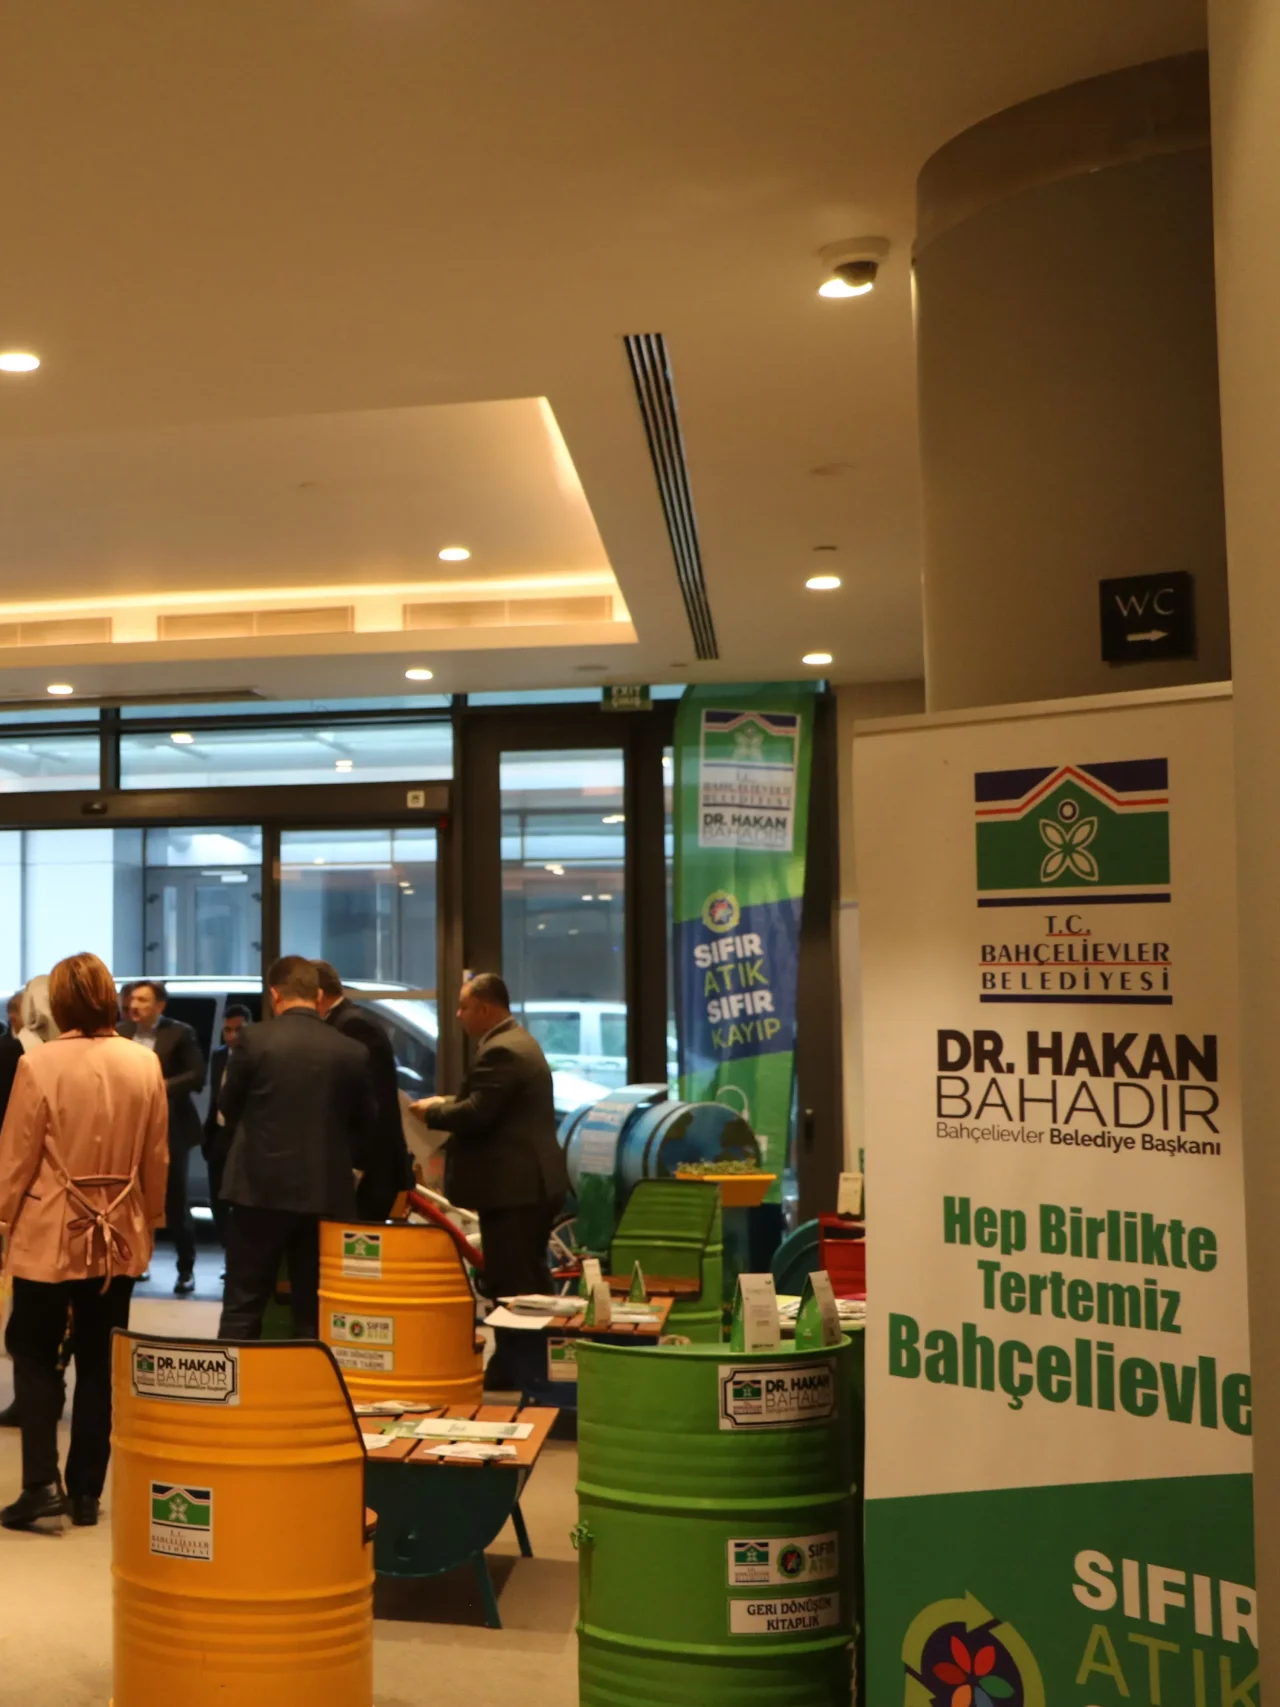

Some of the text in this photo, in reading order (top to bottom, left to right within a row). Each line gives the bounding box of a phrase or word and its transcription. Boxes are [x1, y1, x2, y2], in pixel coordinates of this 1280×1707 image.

[1115, 588, 1174, 617] WC
[704, 813, 787, 829] DR. HAKAN
[1045, 915, 1091, 935] T.C.
[694, 932, 763, 968] SIFIR
[981, 939, 1170, 965] BAHÇELİEVLER
[704, 959, 769, 997] ATIK
[982, 967, 1169, 991] BELEDİYESİ
[707, 989, 775, 1023] SIFIR
[711, 1017, 782, 1050] KAYIP
[937, 1029, 1218, 1082] DR. HAKAN
[936, 1076, 1220, 1134] BAHADIR
[936, 1122, 1220, 1157] Bahçelievler Belediye Başkanı
[943, 1196, 1217, 1272] Hep Birlikte
[977, 1260, 1181, 1334] Tertemiz
[157, 1357, 226, 1372] DR. HAKAN
[157, 1369, 227, 1385] BAHADIR
[888, 1312, 1253, 1436] Bahçelievle
[766, 1379, 788, 1392] DR.
[747, 1603, 777, 1616] GERİ
[1072, 1549, 1258, 1649] SIFIR
[767, 1615, 819, 1631] KİTAPLIK
[1076, 1624, 1260, 1707] ATIK
